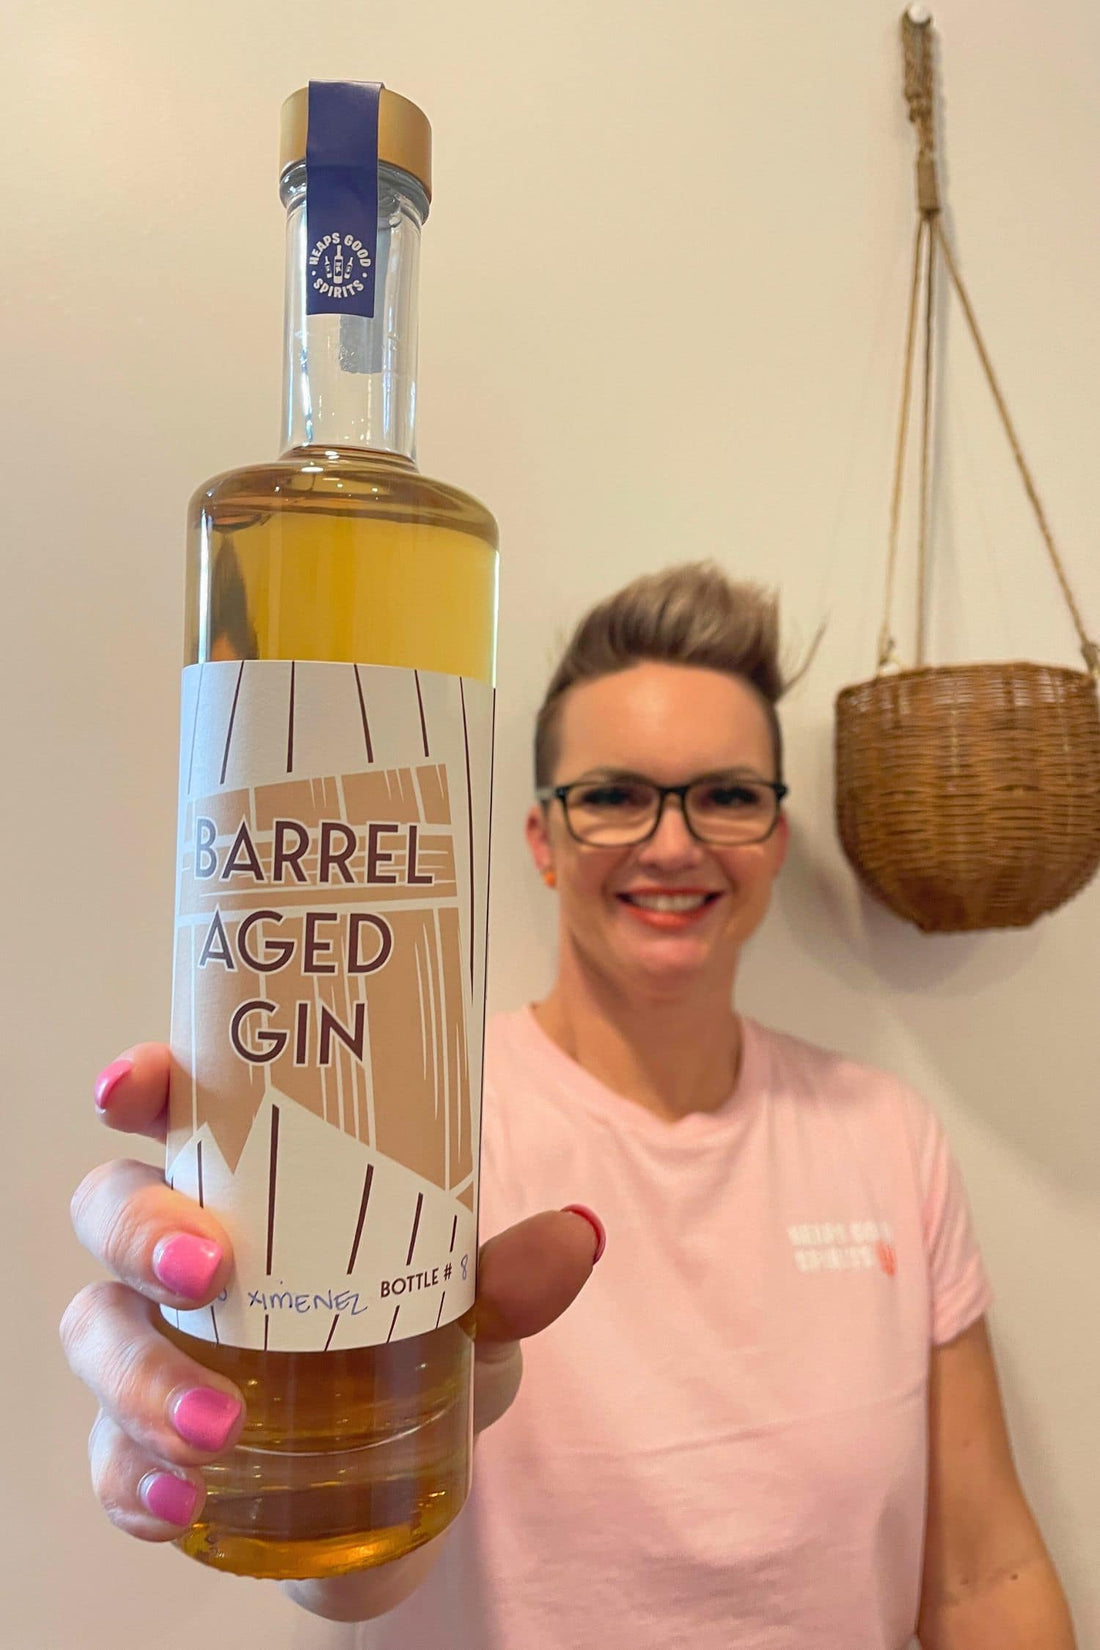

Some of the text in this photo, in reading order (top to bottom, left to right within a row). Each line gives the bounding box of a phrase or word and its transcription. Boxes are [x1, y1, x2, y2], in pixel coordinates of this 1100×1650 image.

[309, 232, 372, 268] HEAPS GOOD
[313, 278, 365, 299] SPIRITS
[195, 817, 433, 885] BARREL
[199, 907, 392, 974] AGED
[230, 999, 366, 1065] GIN
[380, 1254, 468, 1298] BOTTLE # 8
[247, 1284, 368, 1316] XIMENEZ
